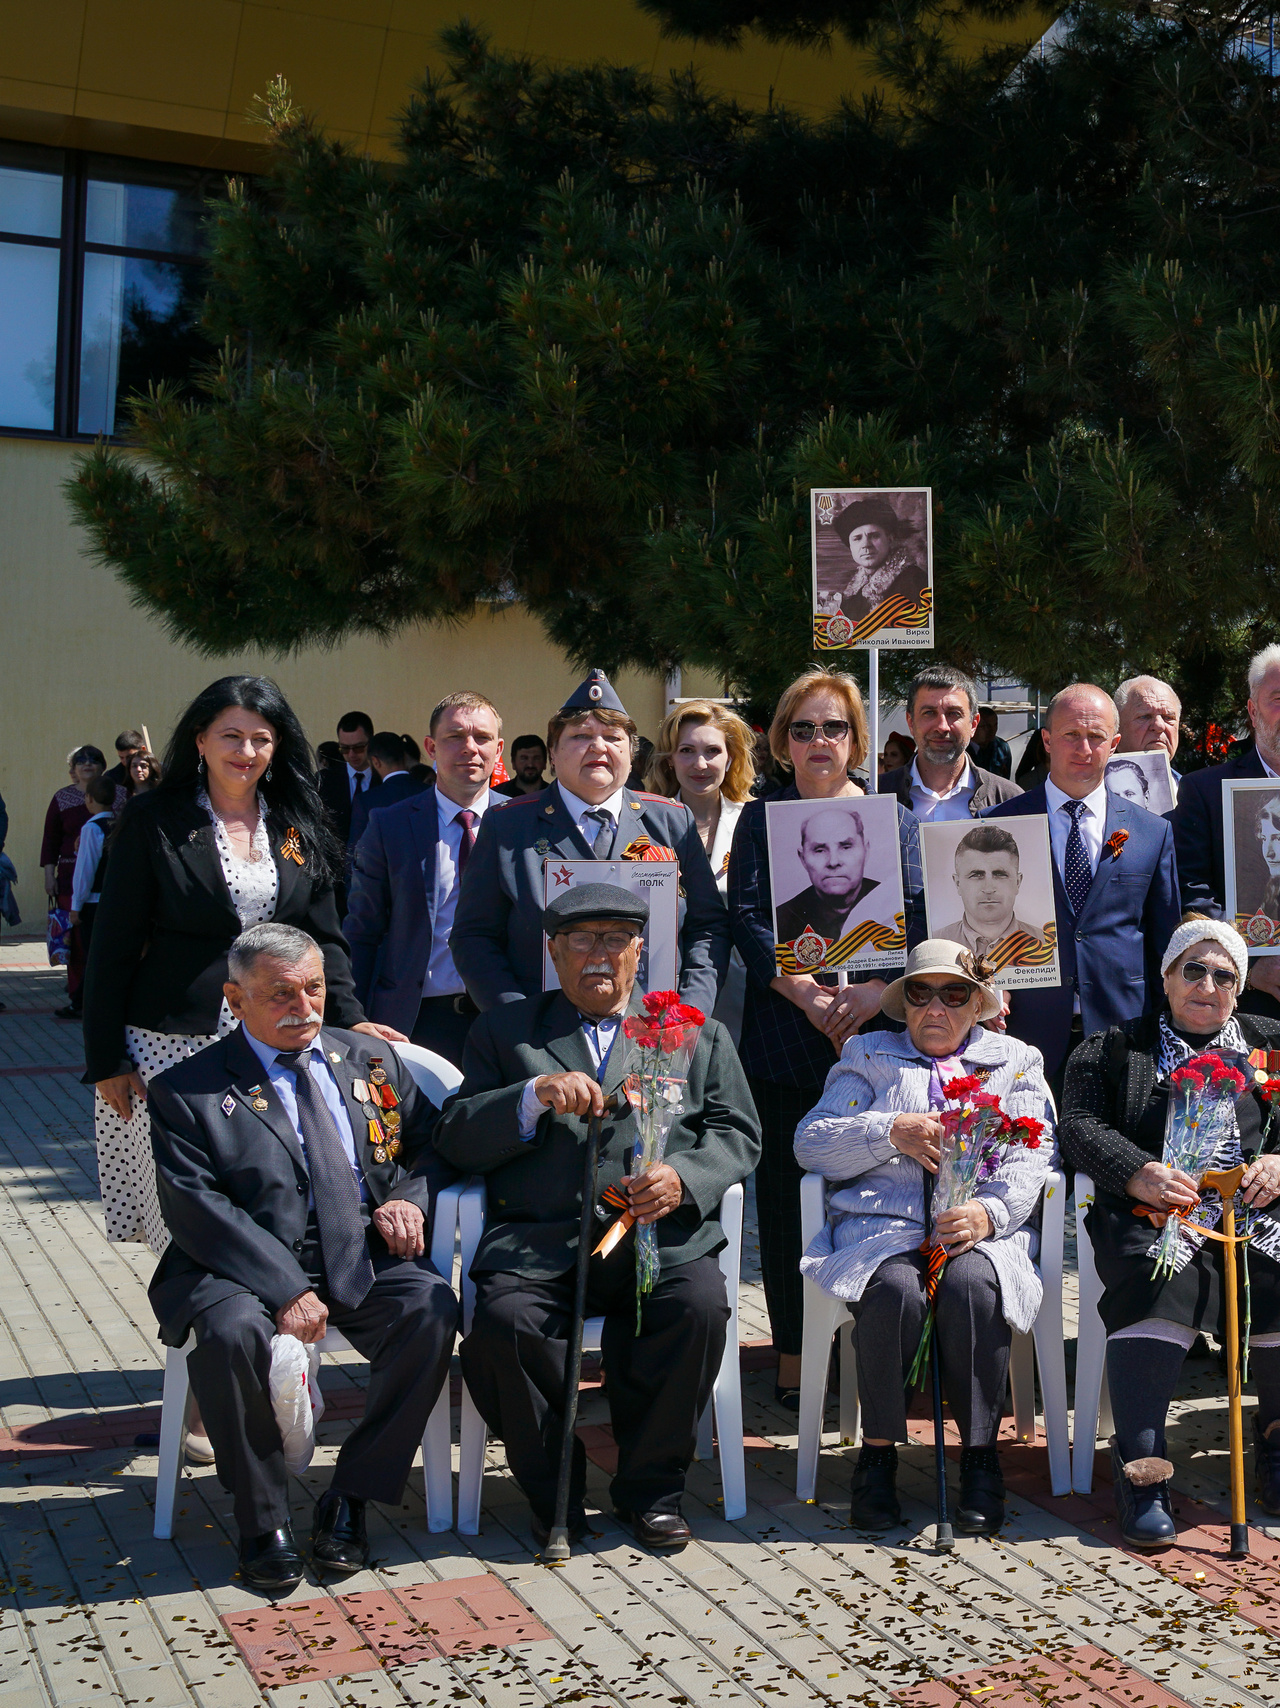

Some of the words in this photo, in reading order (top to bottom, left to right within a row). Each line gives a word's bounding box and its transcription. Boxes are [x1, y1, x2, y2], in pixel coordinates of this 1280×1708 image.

[905, 629, 930, 637] Вирко
[1014, 967, 1057, 975] Фекелиди
[1007, 976, 1058, 985] Евстафьевич
